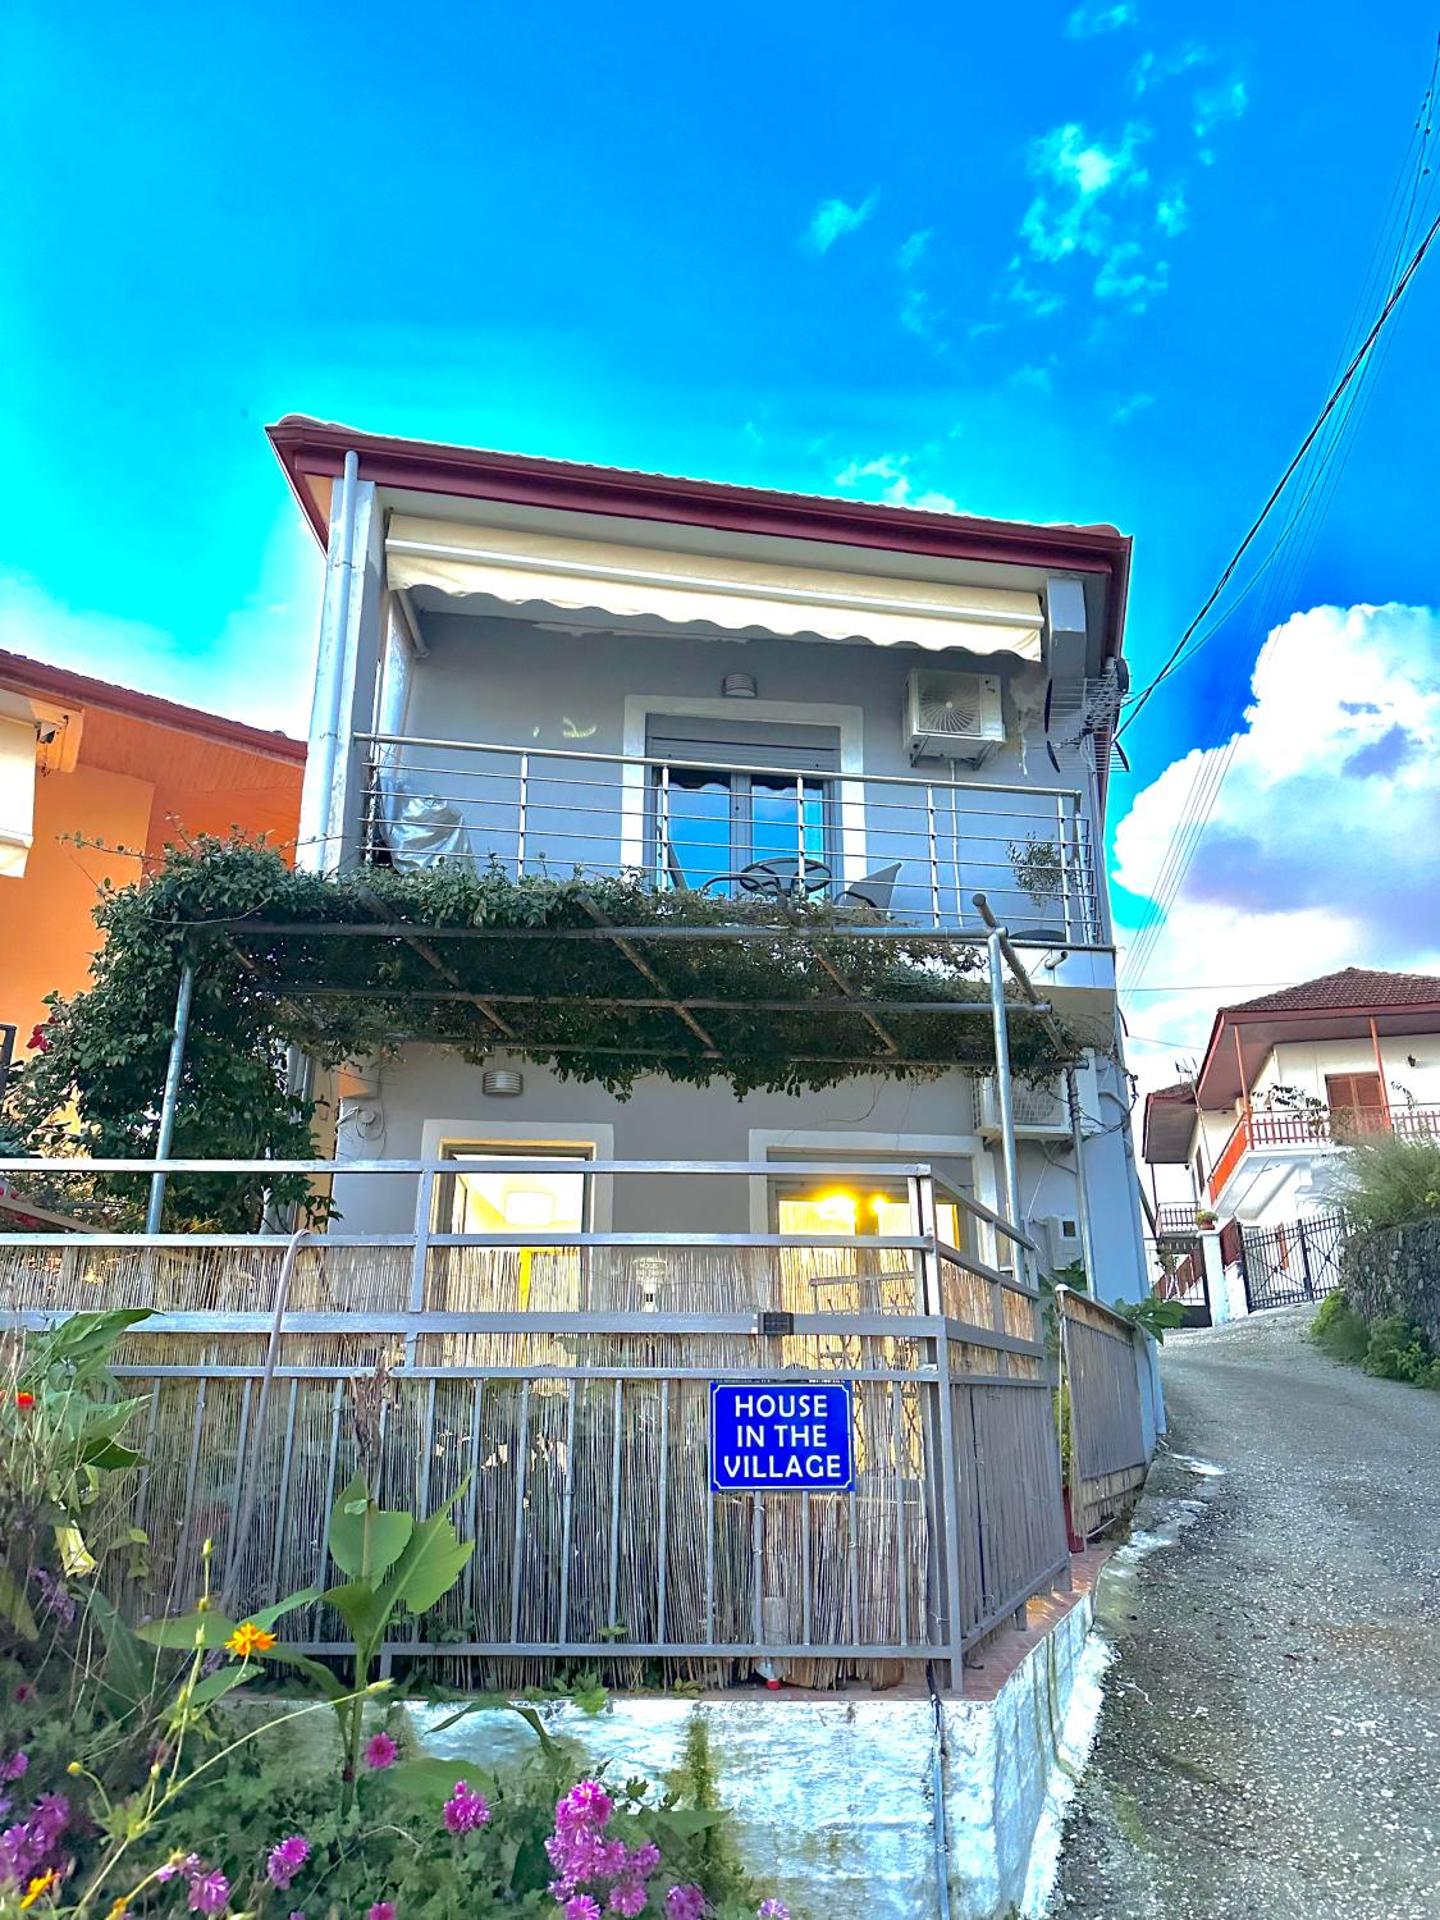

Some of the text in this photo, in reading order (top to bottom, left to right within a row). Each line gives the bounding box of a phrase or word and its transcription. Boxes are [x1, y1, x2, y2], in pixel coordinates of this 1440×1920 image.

[735, 1394, 828, 1418] HOUSE
[737, 1425, 827, 1448] IN THE
[723, 1454, 842, 1478] VILLAGE
